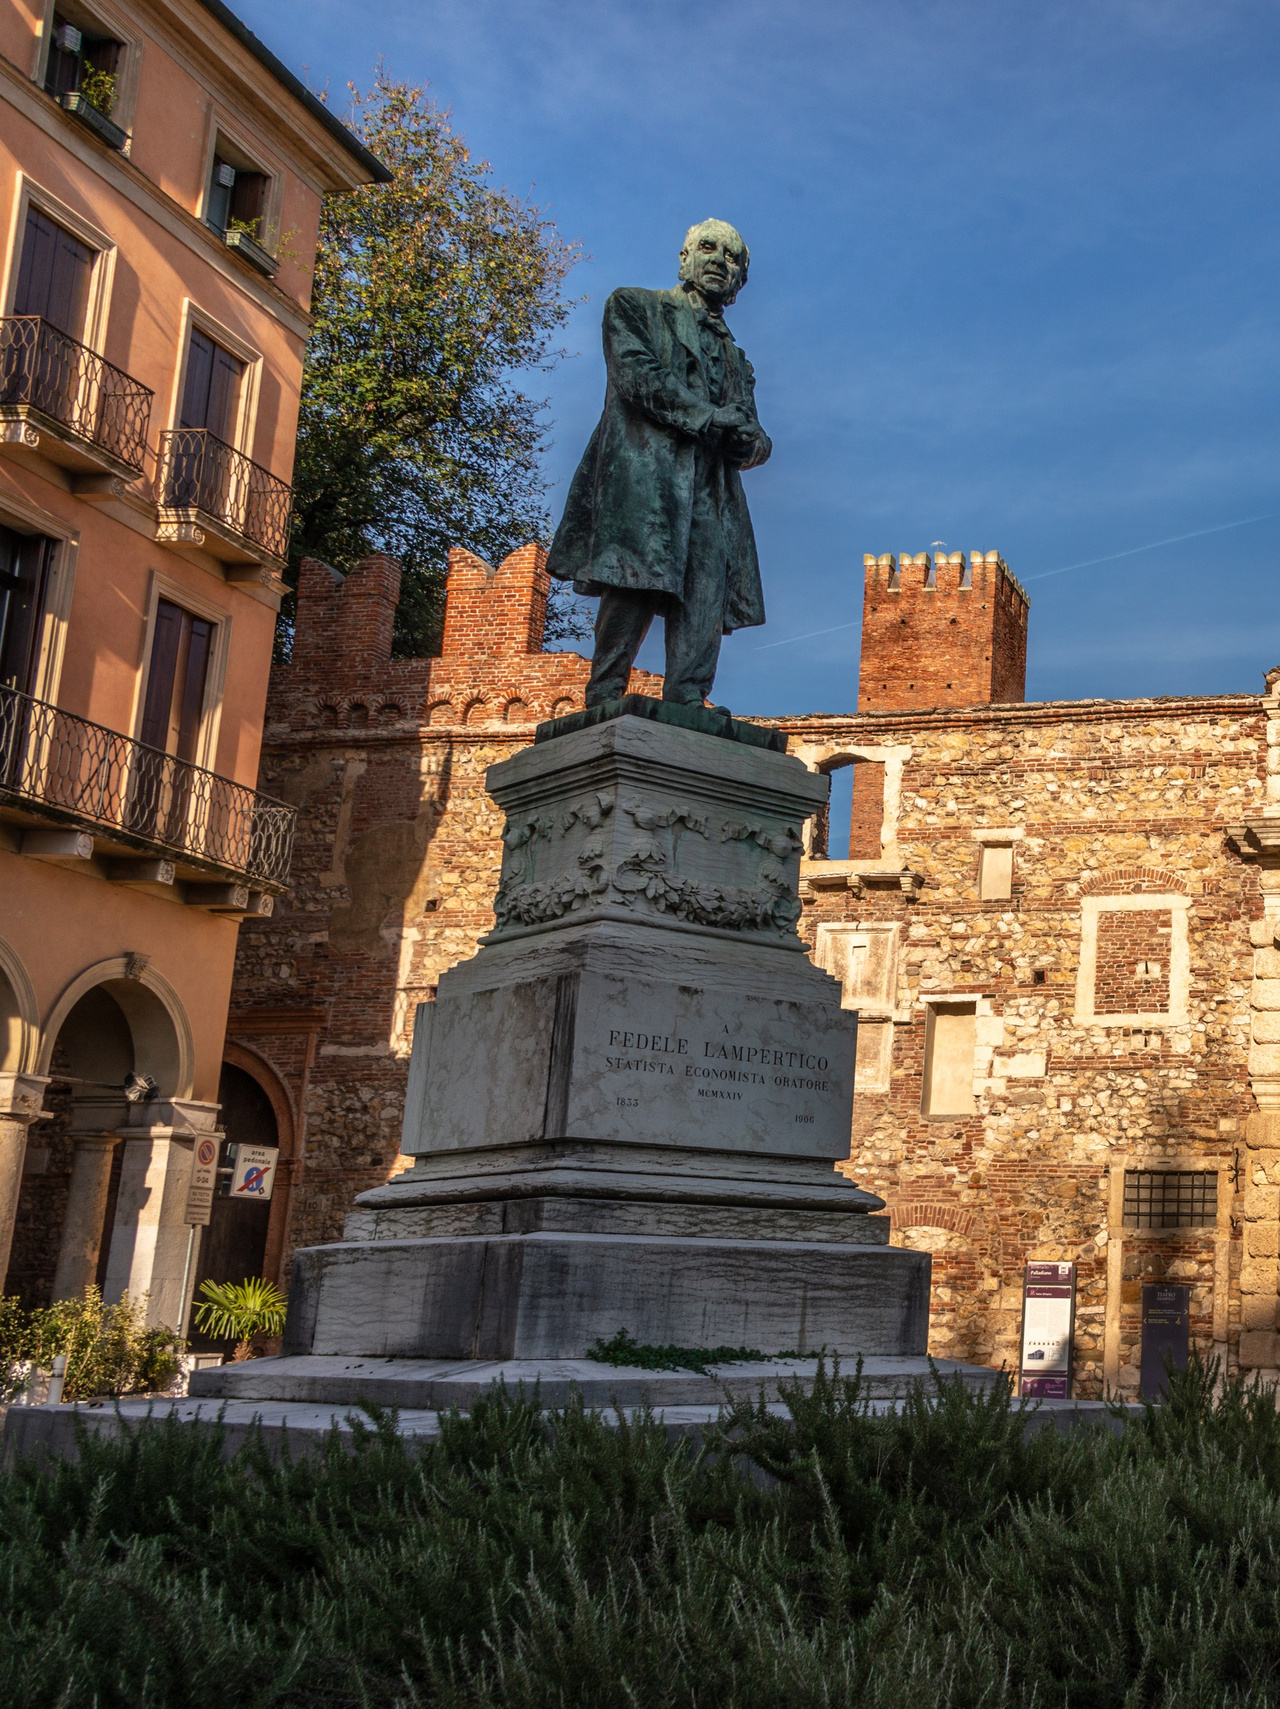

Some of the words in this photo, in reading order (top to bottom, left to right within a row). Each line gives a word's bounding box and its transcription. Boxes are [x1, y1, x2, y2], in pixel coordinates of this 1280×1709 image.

[721, 1023, 730, 1035] A
[608, 1029, 689, 1055] FEDELE
[703, 1041, 829, 1072] LAMPERTICO
[605, 1056, 675, 1075] STATISTA
[685, 1065, 766, 1085] ECONOMISTA
[774, 1075, 829, 1092] ORATORE
[697, 1087, 744, 1101] MCMXXIV
[615, 1096, 639, 1108] 1833
[794, 1113, 815, 1124] 1906
[243, 1156, 271, 1166] pedonale
